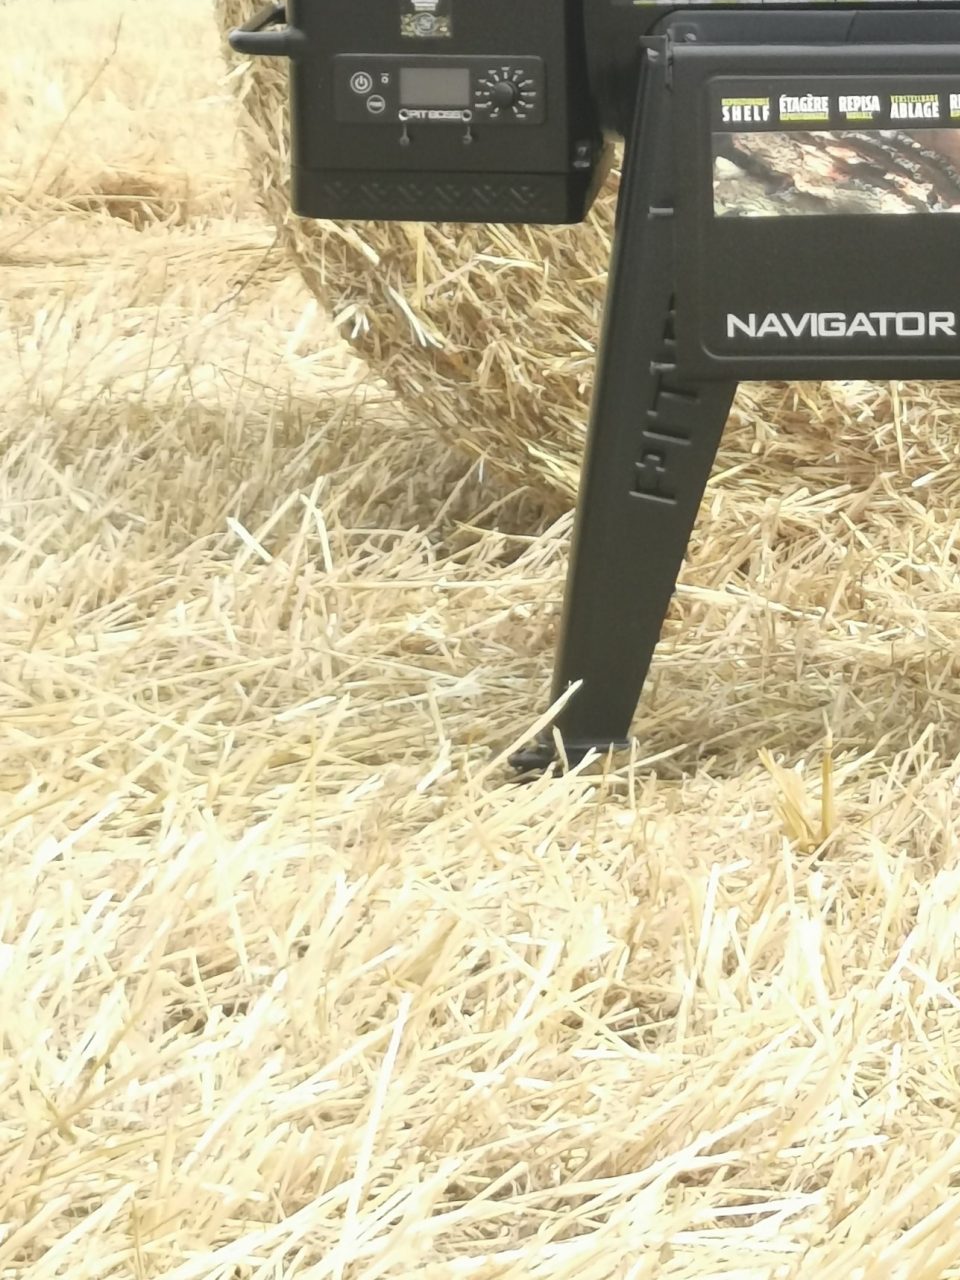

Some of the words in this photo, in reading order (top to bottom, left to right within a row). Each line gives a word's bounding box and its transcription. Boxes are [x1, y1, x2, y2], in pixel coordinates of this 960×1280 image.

[779, 93, 829, 112] ÉTAGÈRE
[839, 96, 880, 112] REPISA
[890, 102, 939, 119] ABLAGE
[722, 105, 770, 121] SHELF
[727, 311, 957, 337] NAVIGATOR
